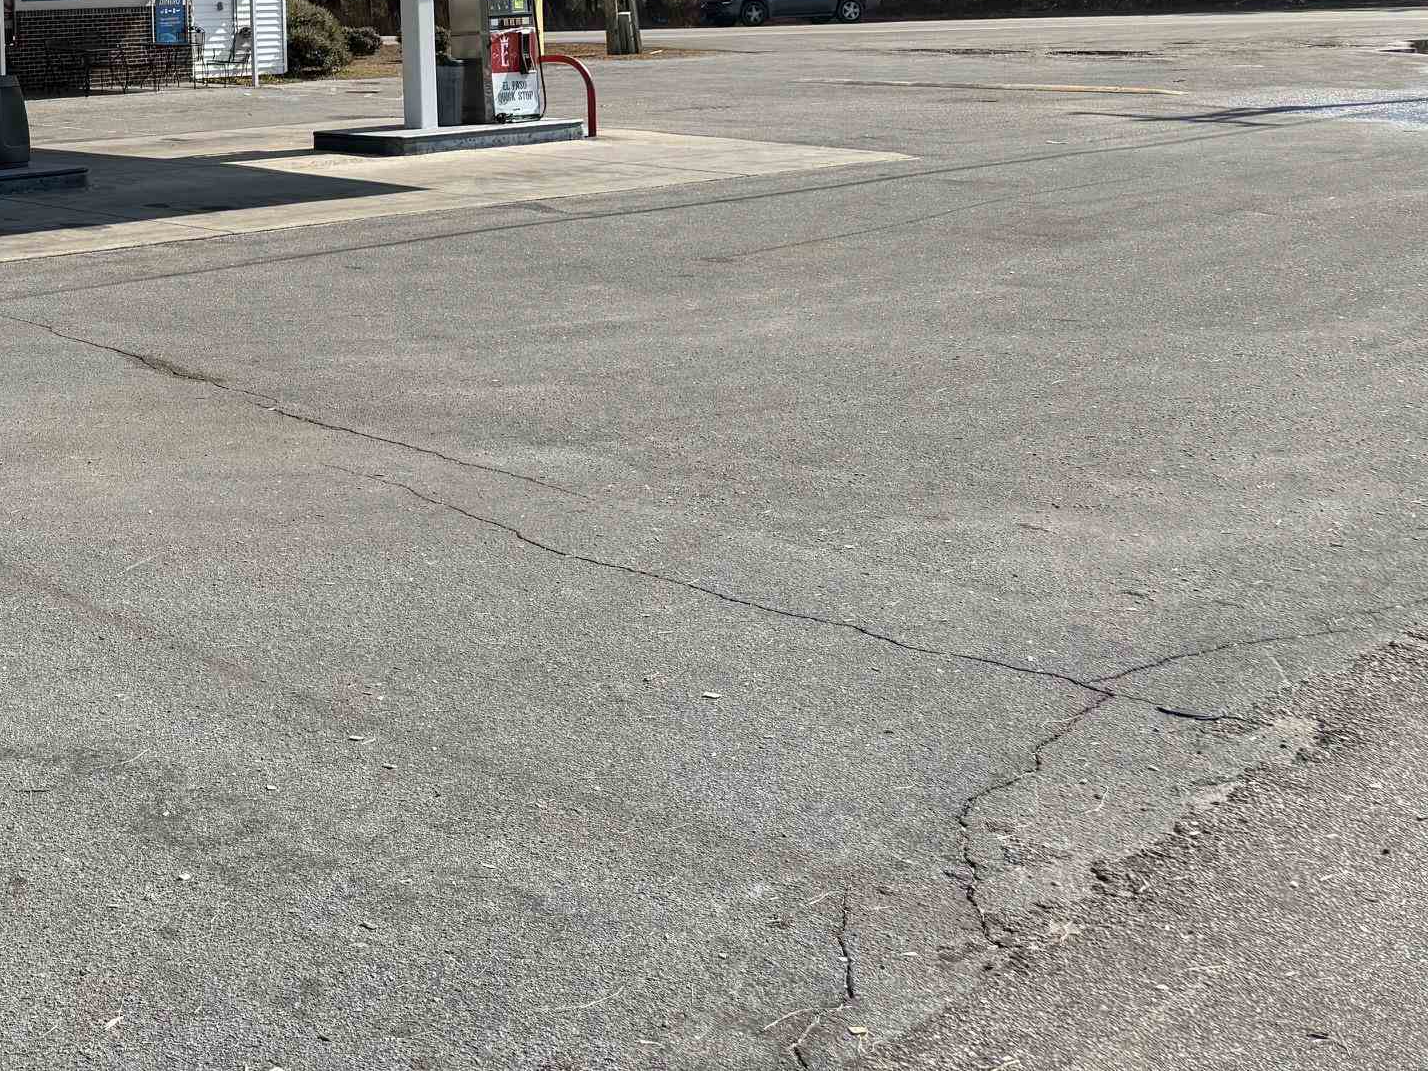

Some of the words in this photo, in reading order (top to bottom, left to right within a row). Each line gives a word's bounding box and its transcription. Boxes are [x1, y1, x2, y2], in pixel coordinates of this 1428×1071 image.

[502, 81, 510, 91] EL
[511, 81, 526, 91] PASO
[517, 91, 533, 101] STOP
